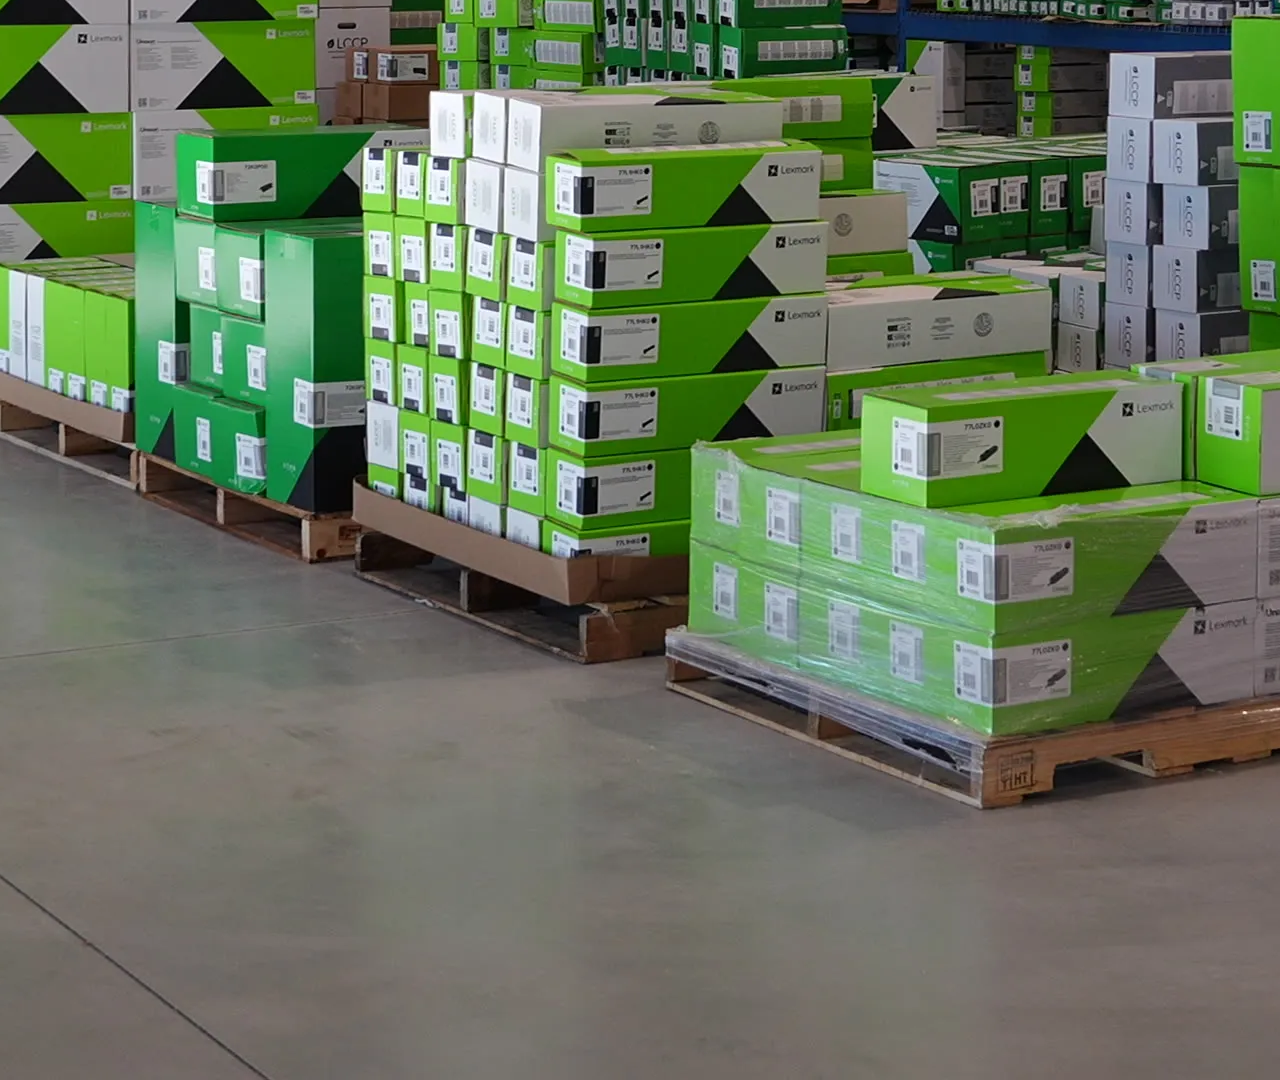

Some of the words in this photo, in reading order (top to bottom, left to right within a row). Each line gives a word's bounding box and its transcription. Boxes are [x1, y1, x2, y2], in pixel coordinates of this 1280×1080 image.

[90, 34, 123, 42] Lexmark
[336, 37, 368, 49] LCCP
[1131, 74, 1139, 107] LCCP
[1127, 137, 1135, 170] LCCP
[1175, 140, 1183, 174] LCCP
[780, 164, 815, 174] Lexmark
[1123, 200, 1132, 233] LCCP
[1185, 204, 1193, 238] LCCP
[788, 236, 821, 246] Lexmark
[1174, 267, 1182, 301] LCCP
[787, 310, 821, 321] Lexmark
[784, 381, 818, 393] Lexmark
[1136, 400, 1175, 414] Lexmark
[1209, 617, 1248, 632] Lexmark
